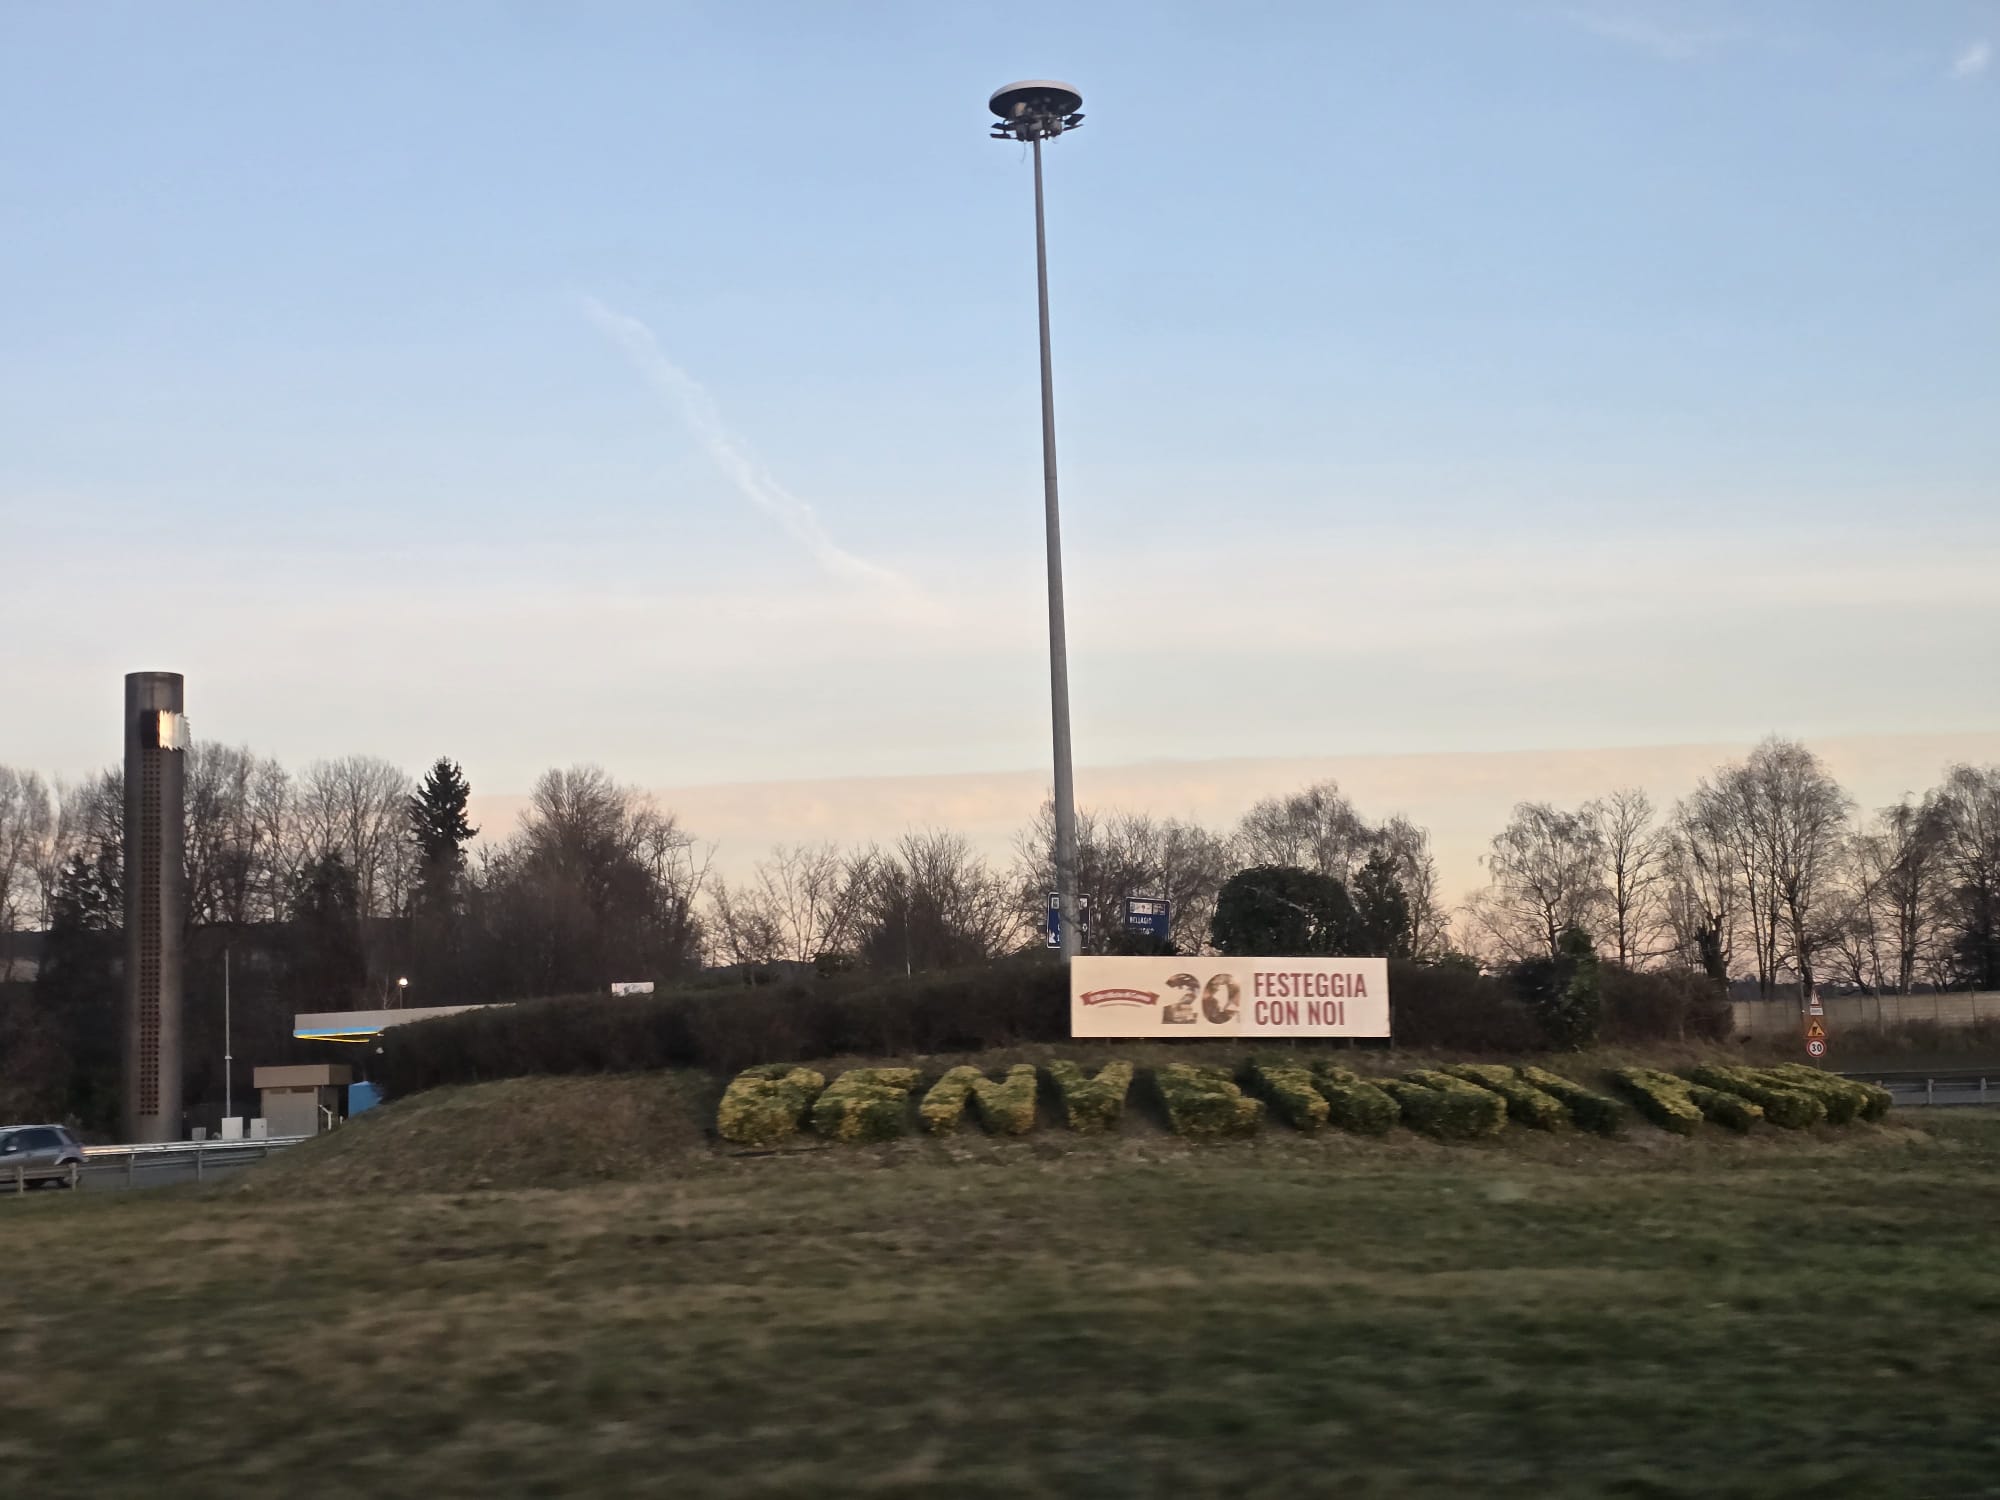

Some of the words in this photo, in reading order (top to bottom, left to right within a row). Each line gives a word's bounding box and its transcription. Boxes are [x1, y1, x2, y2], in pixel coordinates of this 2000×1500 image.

[1254, 973, 1368, 998] FESTEGGIA
[1161, 973, 1240, 1024] 20
[1255, 1001, 1300, 1026] CON
[1308, 1001, 1346, 1026] NOI
[1811, 1043, 1823, 1052] 30
